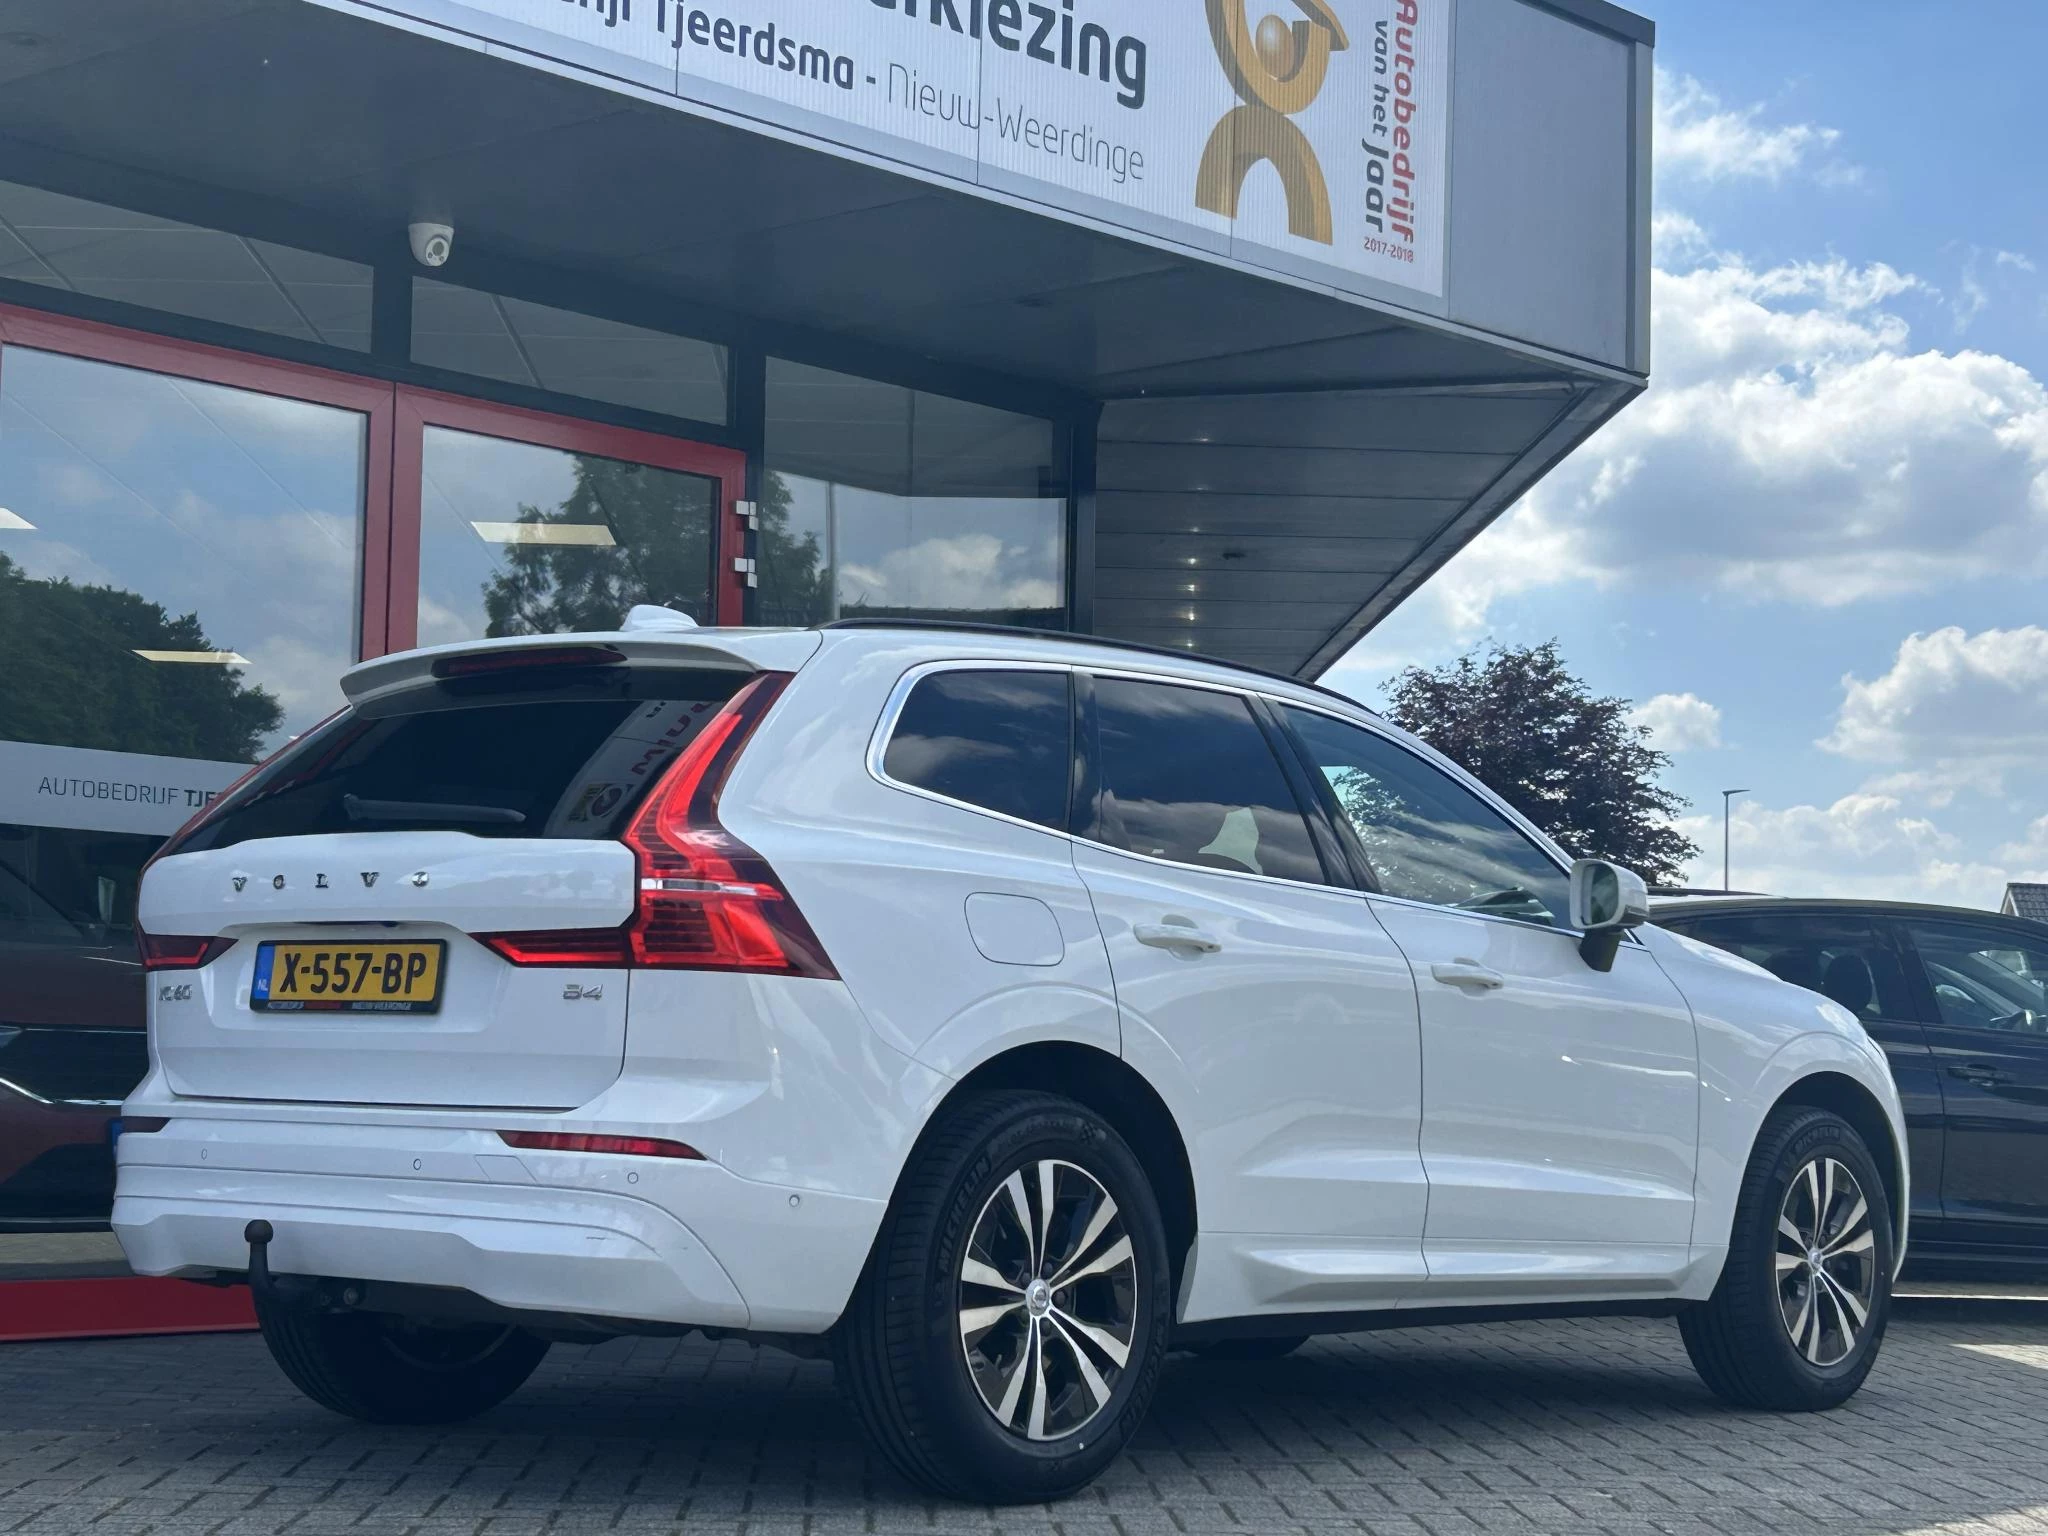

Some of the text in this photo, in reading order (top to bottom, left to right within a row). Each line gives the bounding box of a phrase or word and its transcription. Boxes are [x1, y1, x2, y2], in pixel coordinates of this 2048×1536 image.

[869, 0, 1148, 110] iezing
[1361, 20, 1390, 234] van het Jaar
[1386, 0, 1419, 244] Autobedrijf
[1363, 236, 1414, 264] 2017-2018
[38, 776, 224, 807] AUTOBEDRIJF TJE
[232, 871, 430, 892] VOLVO
[279, 952, 427, 994] X-557-BP
